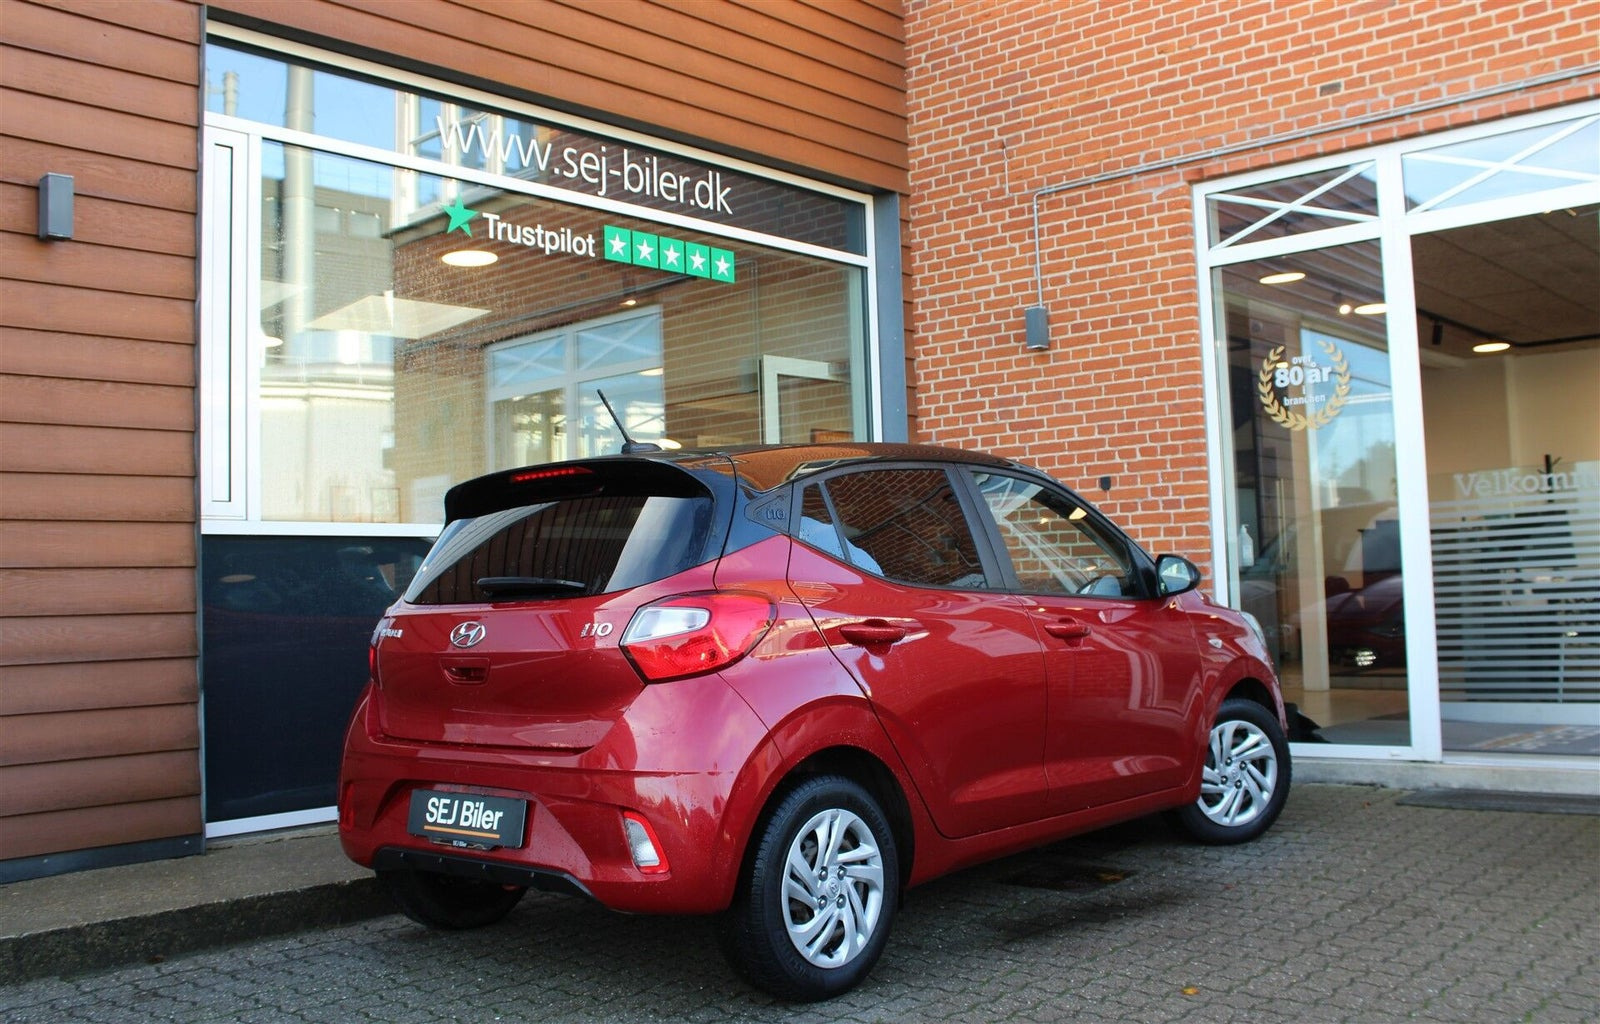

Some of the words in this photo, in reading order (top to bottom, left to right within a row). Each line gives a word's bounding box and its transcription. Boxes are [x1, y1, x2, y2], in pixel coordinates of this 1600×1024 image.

[436, 114, 734, 215] www.sej-biler.dk
[482, 212, 596, 258] Trustpilot
[1274, 365, 1304, 388] 80
[1305, 361, 1333, 384] år
[1291, 354, 1313, 365] over
[1283, 393, 1326, 407] branchen
[425, 797, 459, 825] SEJ
[459, 800, 504, 831] Biler
